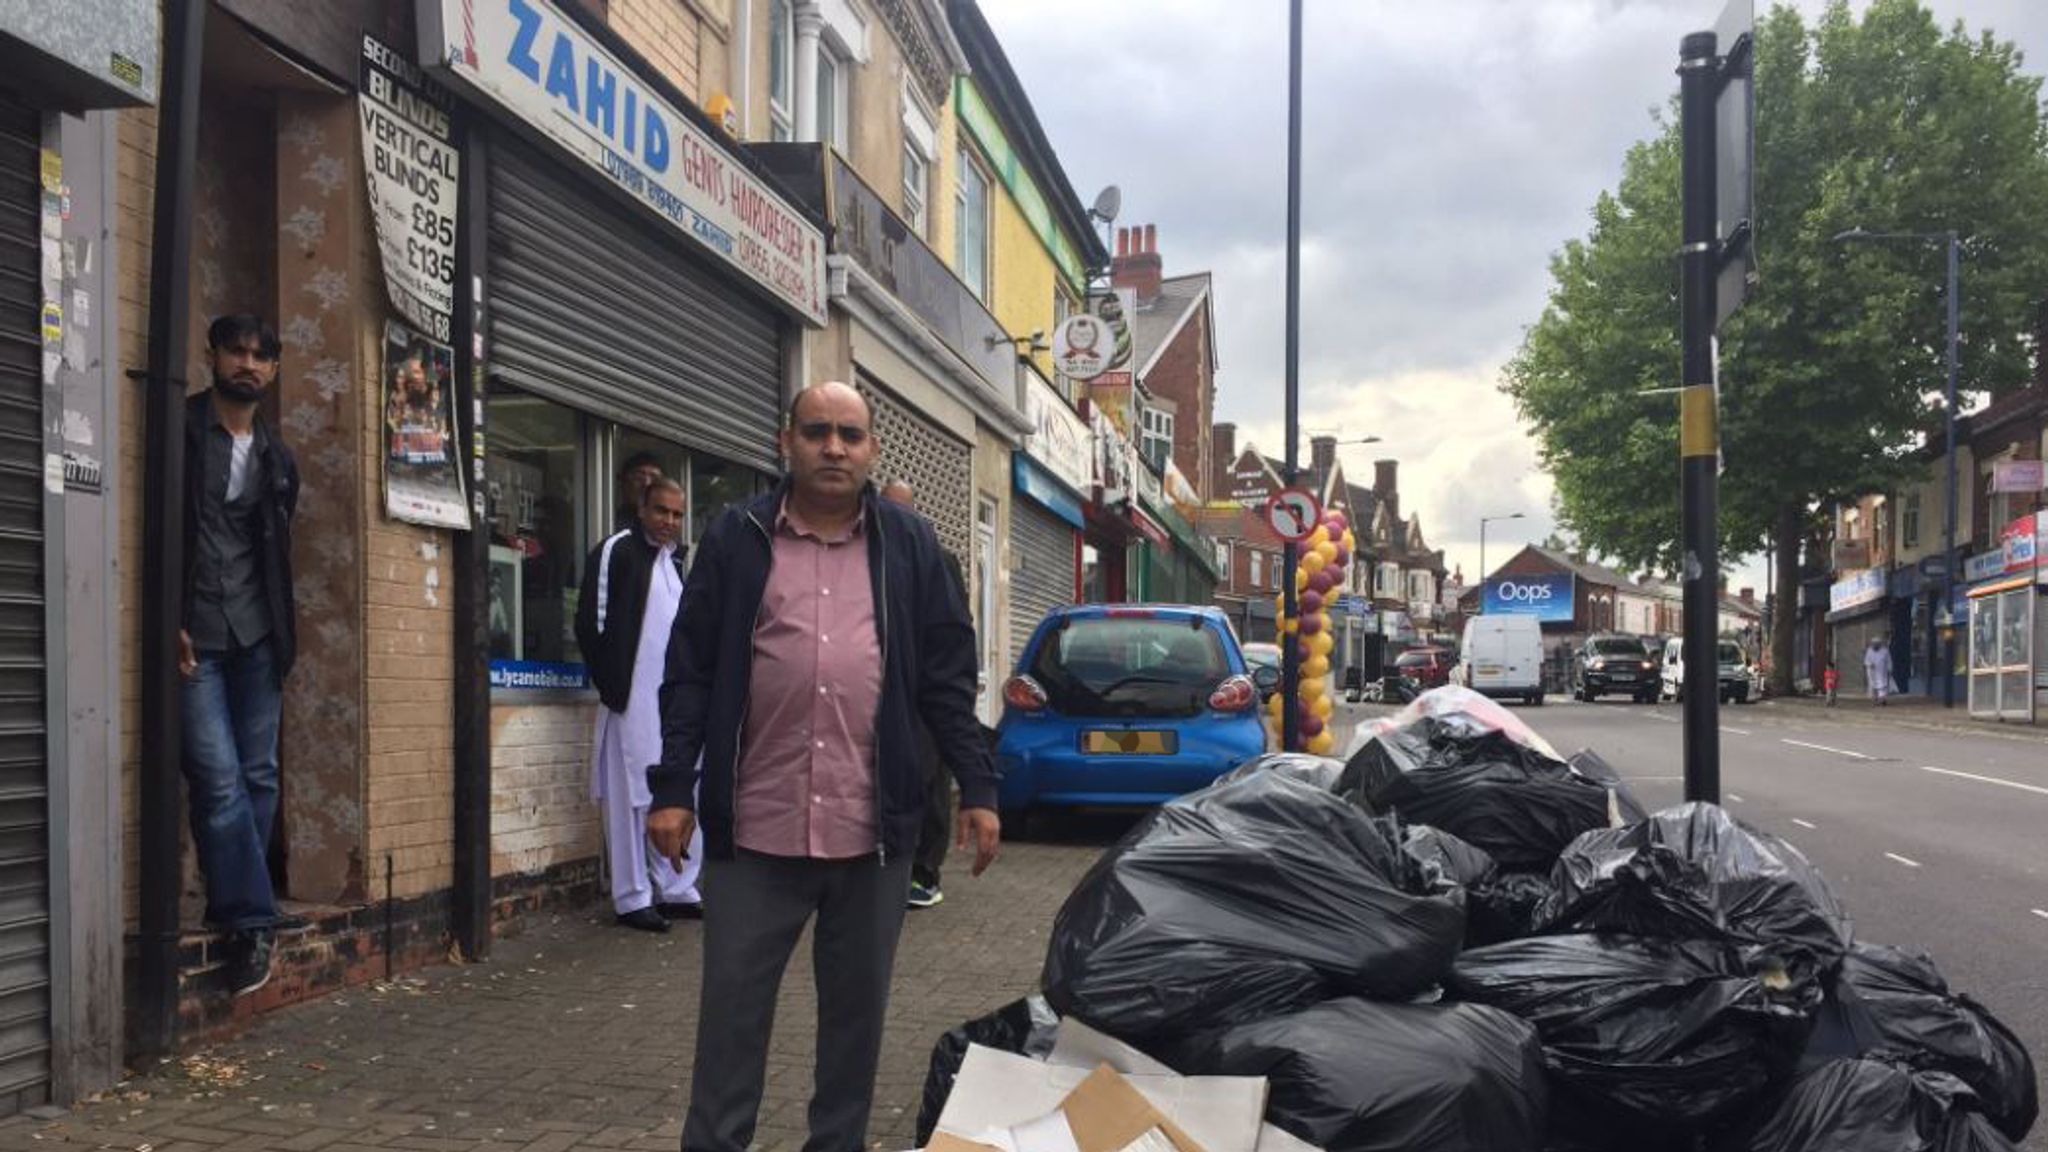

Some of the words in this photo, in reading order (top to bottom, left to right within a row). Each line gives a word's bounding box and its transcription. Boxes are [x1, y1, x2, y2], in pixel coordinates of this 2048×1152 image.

[369, 67, 449, 140] BLINDS
[507, 0, 669, 174] ZAHID
[361, 101, 455, 182] VERTICAL
[374, 143, 440, 205] BLINDS
[682, 133, 726, 206] GENTS
[412, 202, 453, 247] £85
[407, 236, 455, 285] £135
[1499, 581, 1552, 605] Oops
